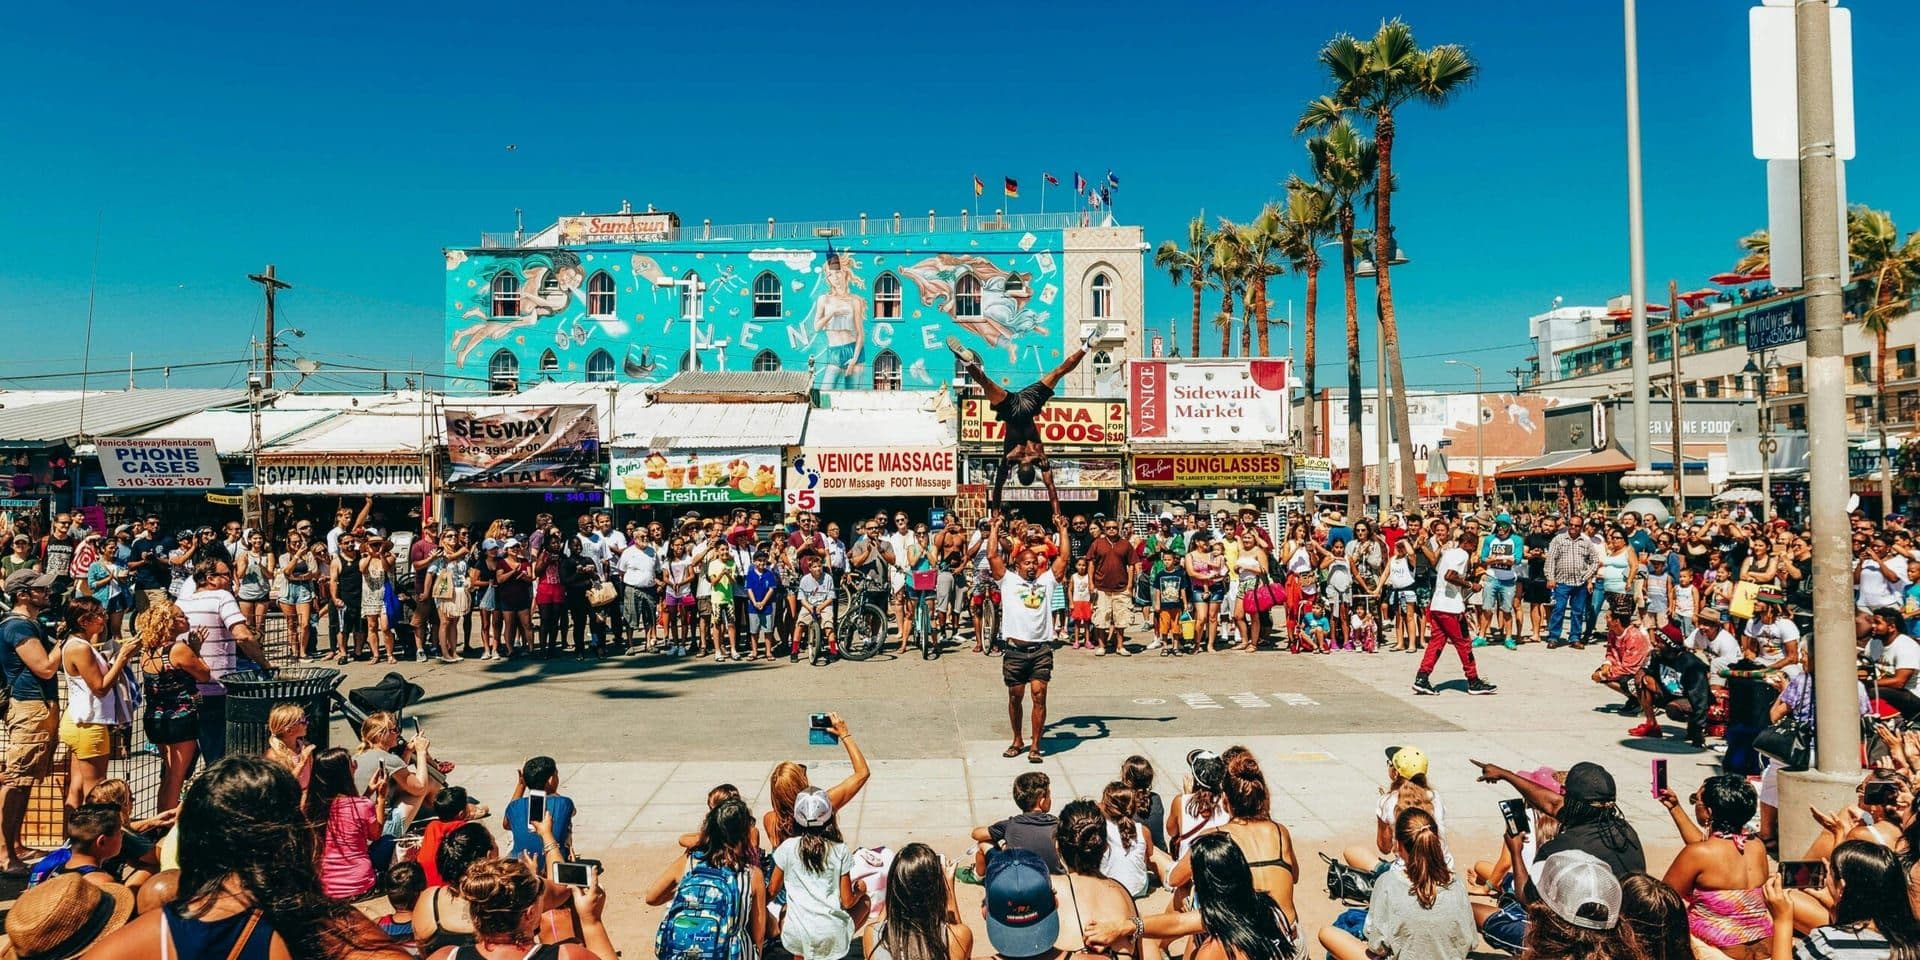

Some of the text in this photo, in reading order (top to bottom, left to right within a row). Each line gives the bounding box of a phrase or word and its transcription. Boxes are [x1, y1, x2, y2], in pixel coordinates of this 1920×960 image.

[589, 217, 664, 234] Samesun
[1141, 365, 1156, 433] VENICE
[1173, 384, 1262, 400] Sidewalk
[965, 400, 977, 417] 2
[1034, 407, 1093, 423] NNA
[1109, 404, 1122, 421] 2
[1175, 404, 1244, 418] Market
[453, 416, 553, 439] SEGWAY
[962, 428, 980, 439] $10
[982, 421, 1106, 443] TATOOS
[1665, 420, 1697, 433] WNE
[1701, 420, 1732, 433] FOOD
[96, 439, 212, 448] VeniceSegwayRental.com
[1107, 432, 1124, 442] $10
[115, 448, 199, 460] PHONE
[122, 461, 200, 473] CASES
[817, 452, 954, 473] VENICE MASSAGE
[1176, 457, 1281, 473] SUNGLASSES
[118, 477, 213, 487] 310-302-7867
[257, 465, 424, 485] EGYPTIAN EXPOSITION
[823, 478, 847, 489] BODY
[849, 478, 886, 490] Massage
[890, 477, 913, 488] FOOT
[915, 477, 952, 489] Massage
[663, 489, 730, 501] Fresh Fruit
[787, 490, 816, 510] $5
